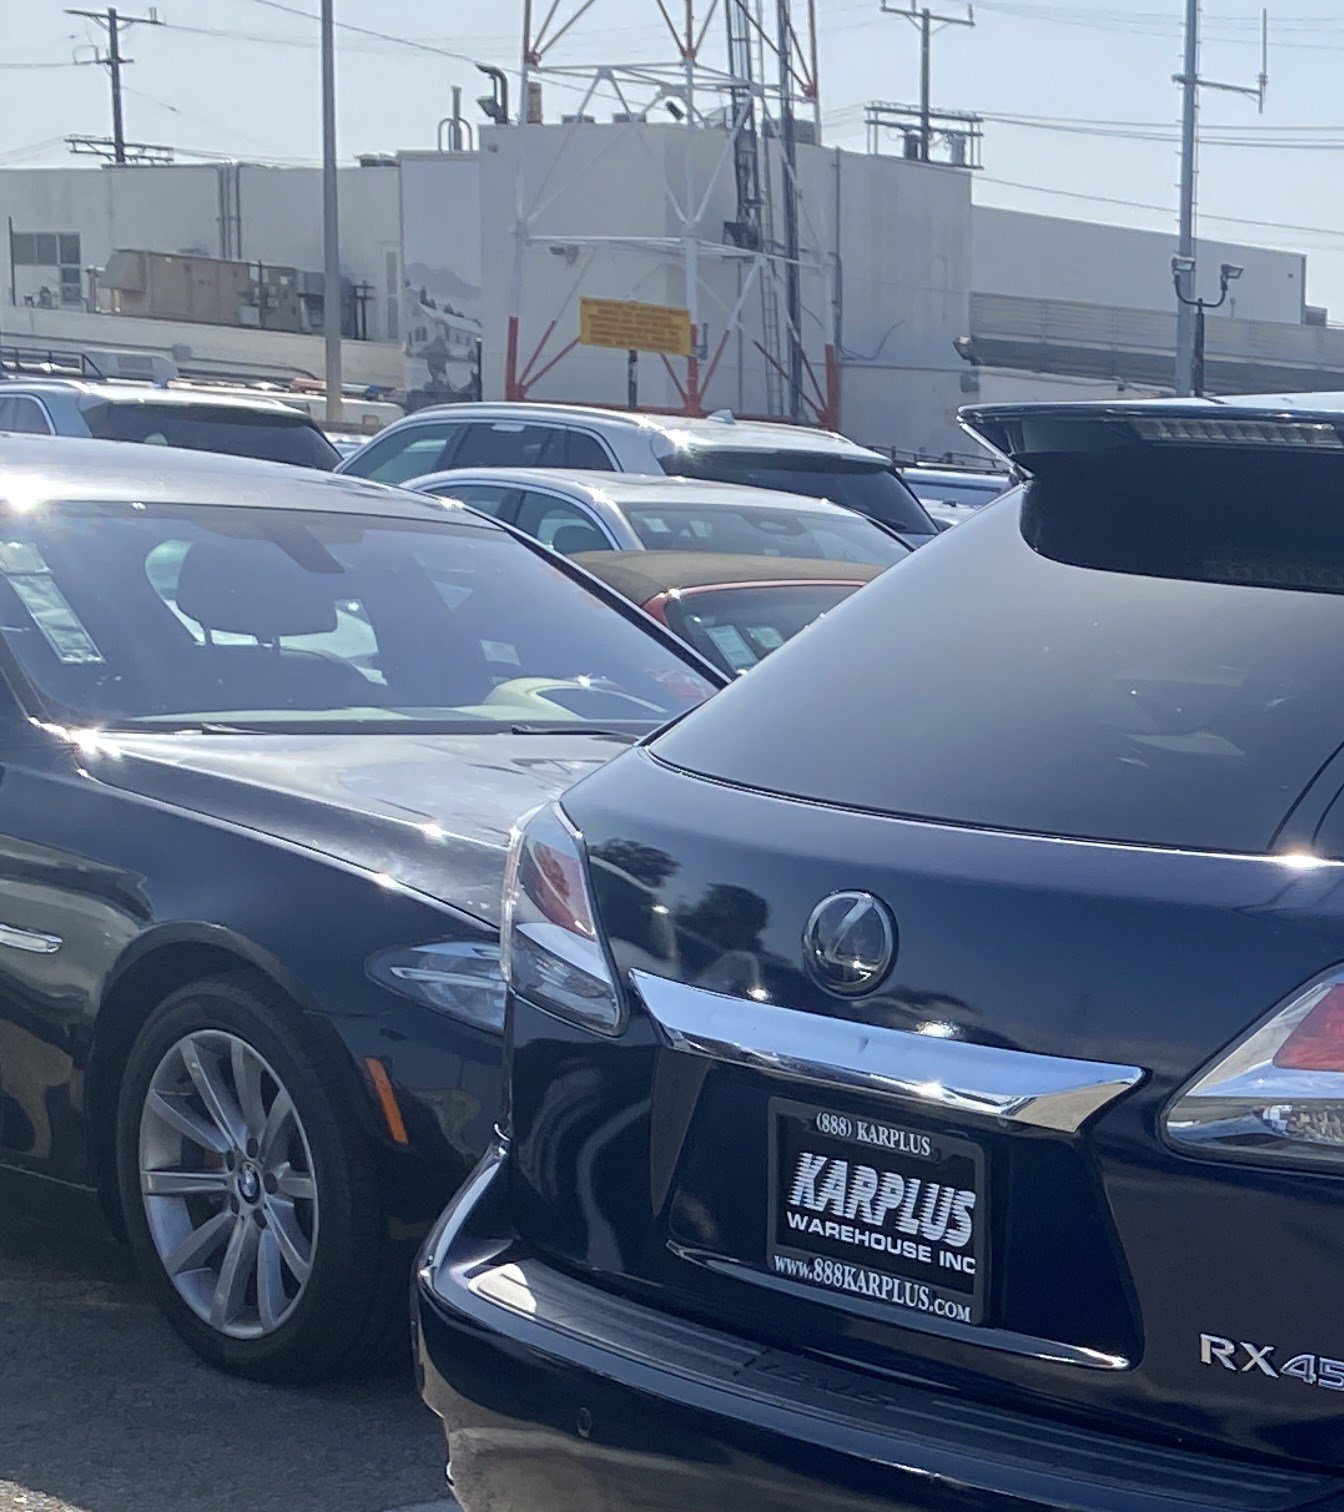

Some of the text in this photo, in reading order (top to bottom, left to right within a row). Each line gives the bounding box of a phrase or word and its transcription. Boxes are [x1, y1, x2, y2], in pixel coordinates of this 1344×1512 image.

[816, 1112, 931, 1156] (888) KARPLUS
[787, 1152, 976, 1247] KARPLUS
[787, 1210, 976, 1275] WAREHOUSE INC
